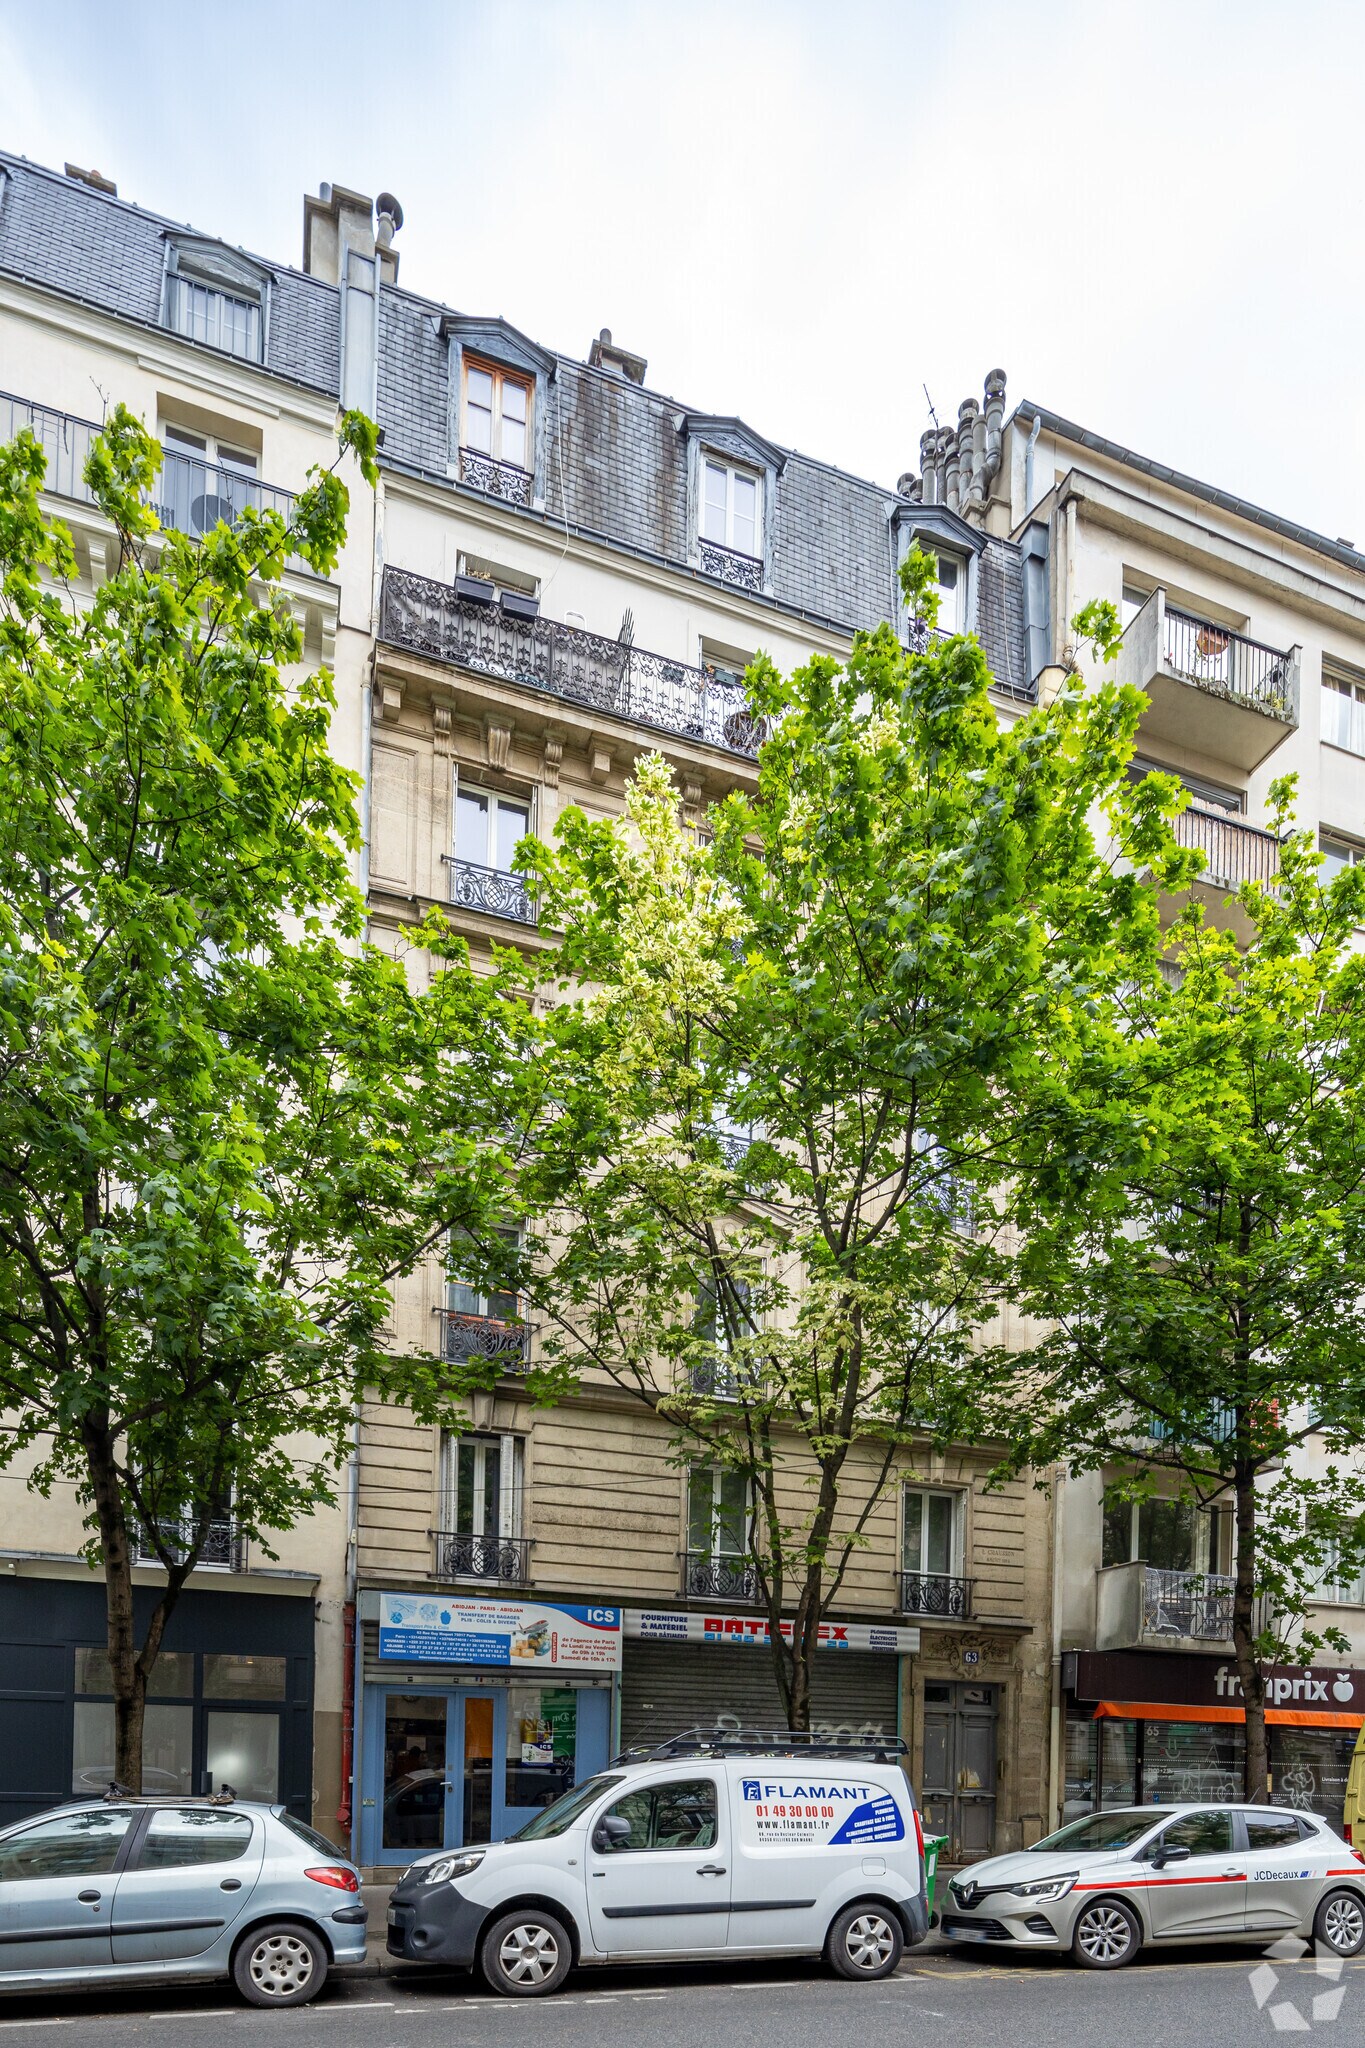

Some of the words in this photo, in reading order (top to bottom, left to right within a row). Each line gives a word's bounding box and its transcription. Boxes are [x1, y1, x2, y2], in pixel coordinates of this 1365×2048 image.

[587, 1609, 614, 1622] ICS
[641, 1614, 688, 1622] FOURNITURE
[650, 1623, 688, 1631] MATÉRIEL
[965, 1652, 977, 1662] 63
[1147, 1726, 1159, 1736] 65
[765, 1786, 870, 1799] FLAMANT
[756, 1805, 768, 1817] 01
[773, 1805, 786, 1817] 49
[789, 1806, 801, 1817] 30
[806, 1806, 817, 1817] 00
[821, 1806, 834, 1818] 00
[757, 1820, 829, 1829] www.flamant.fr
[1254, 1871, 1299, 1880] JCDecaux
